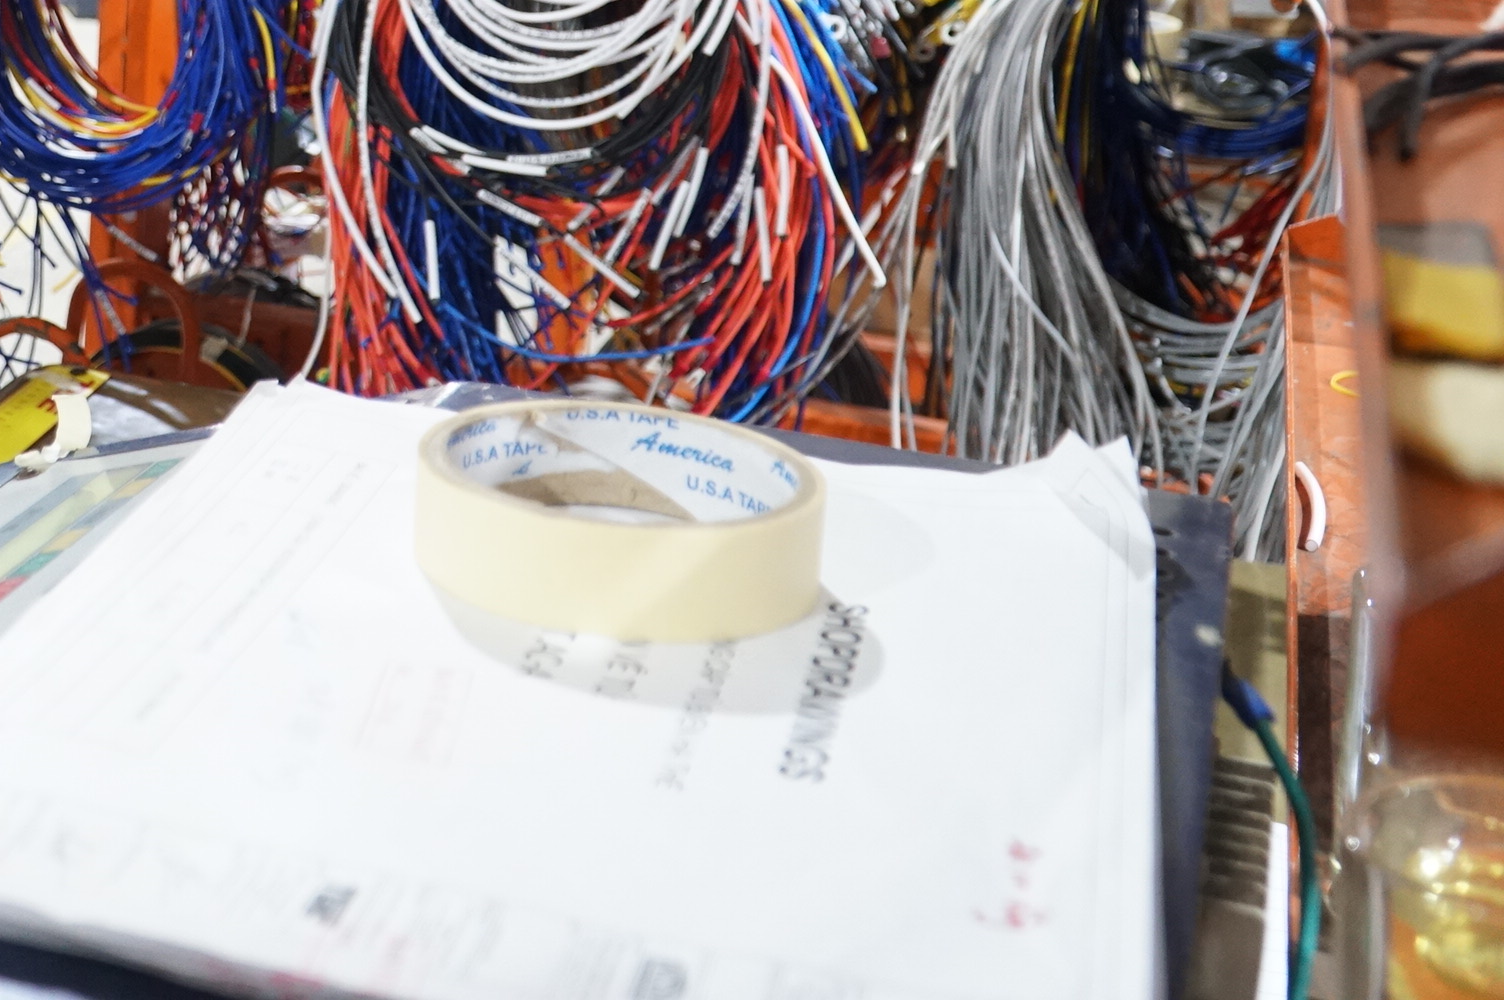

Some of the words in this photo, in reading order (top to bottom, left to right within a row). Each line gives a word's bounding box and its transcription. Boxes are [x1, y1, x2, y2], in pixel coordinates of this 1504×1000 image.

[463, 446, 499, 469] U.S.A
[630, 431, 735, 474] America
[686, 474, 735, 504] U.S.A
